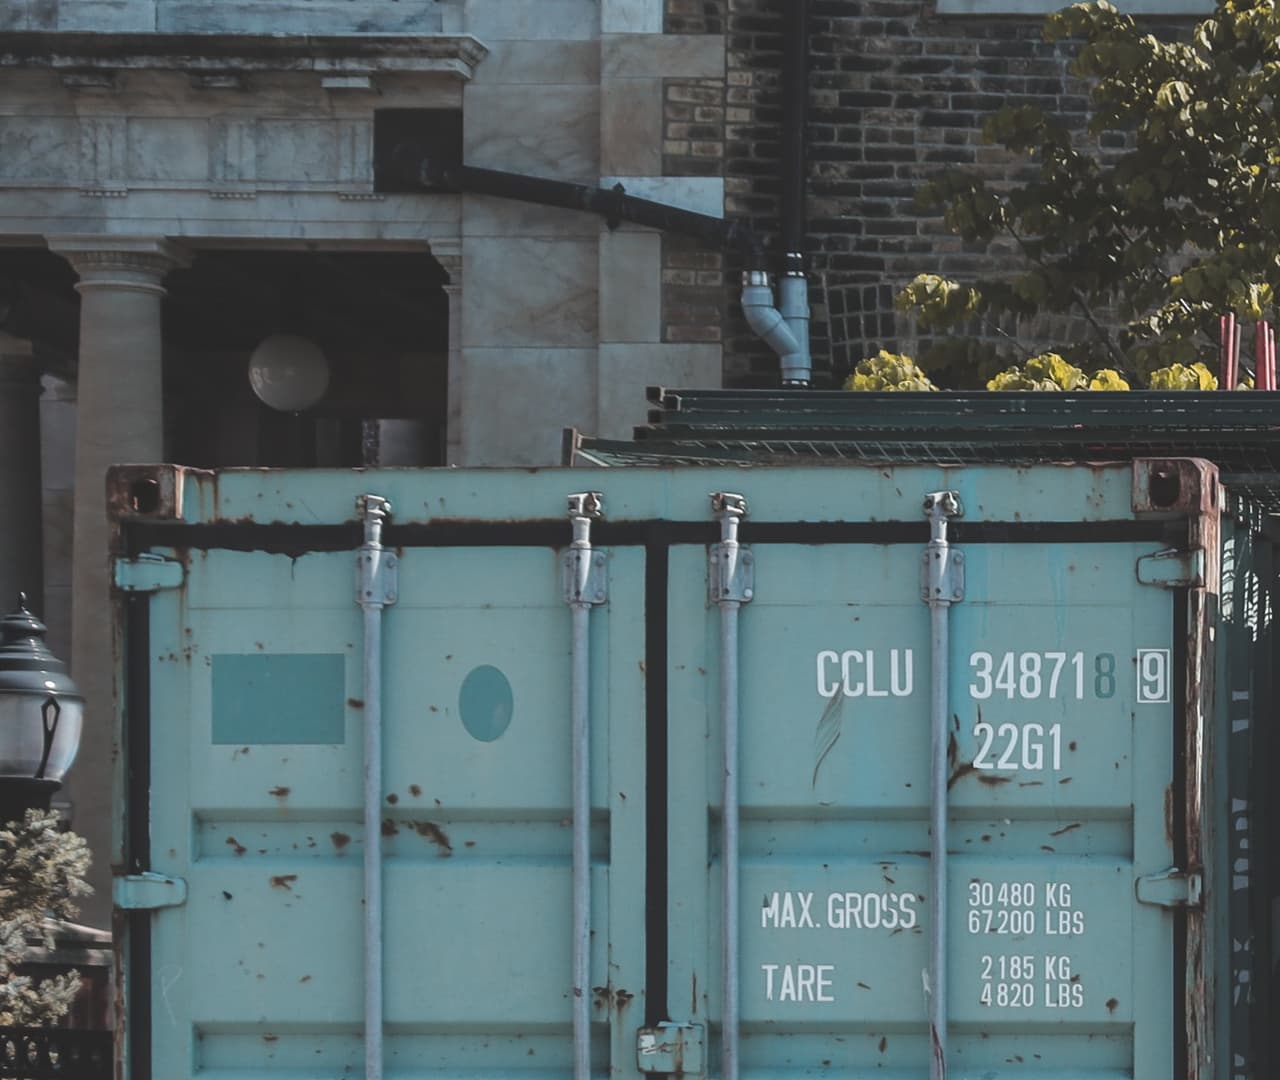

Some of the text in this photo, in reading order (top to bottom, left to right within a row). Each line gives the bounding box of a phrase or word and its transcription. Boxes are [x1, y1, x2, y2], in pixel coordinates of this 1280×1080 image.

[816, 649, 1165, 700] CCLU 348718 9
[972, 722, 1062, 771] 22G1
[761, 891, 821, 928] MAX.
[827, 892, 917, 929] GROSS
[1045, 882, 1071, 907] KG
[1045, 910, 1084, 935] LBS
[761, 964, 835, 1001] TARE
[1044, 955, 1071, 980] KG
[1044, 983, 1083, 1008] LBS
